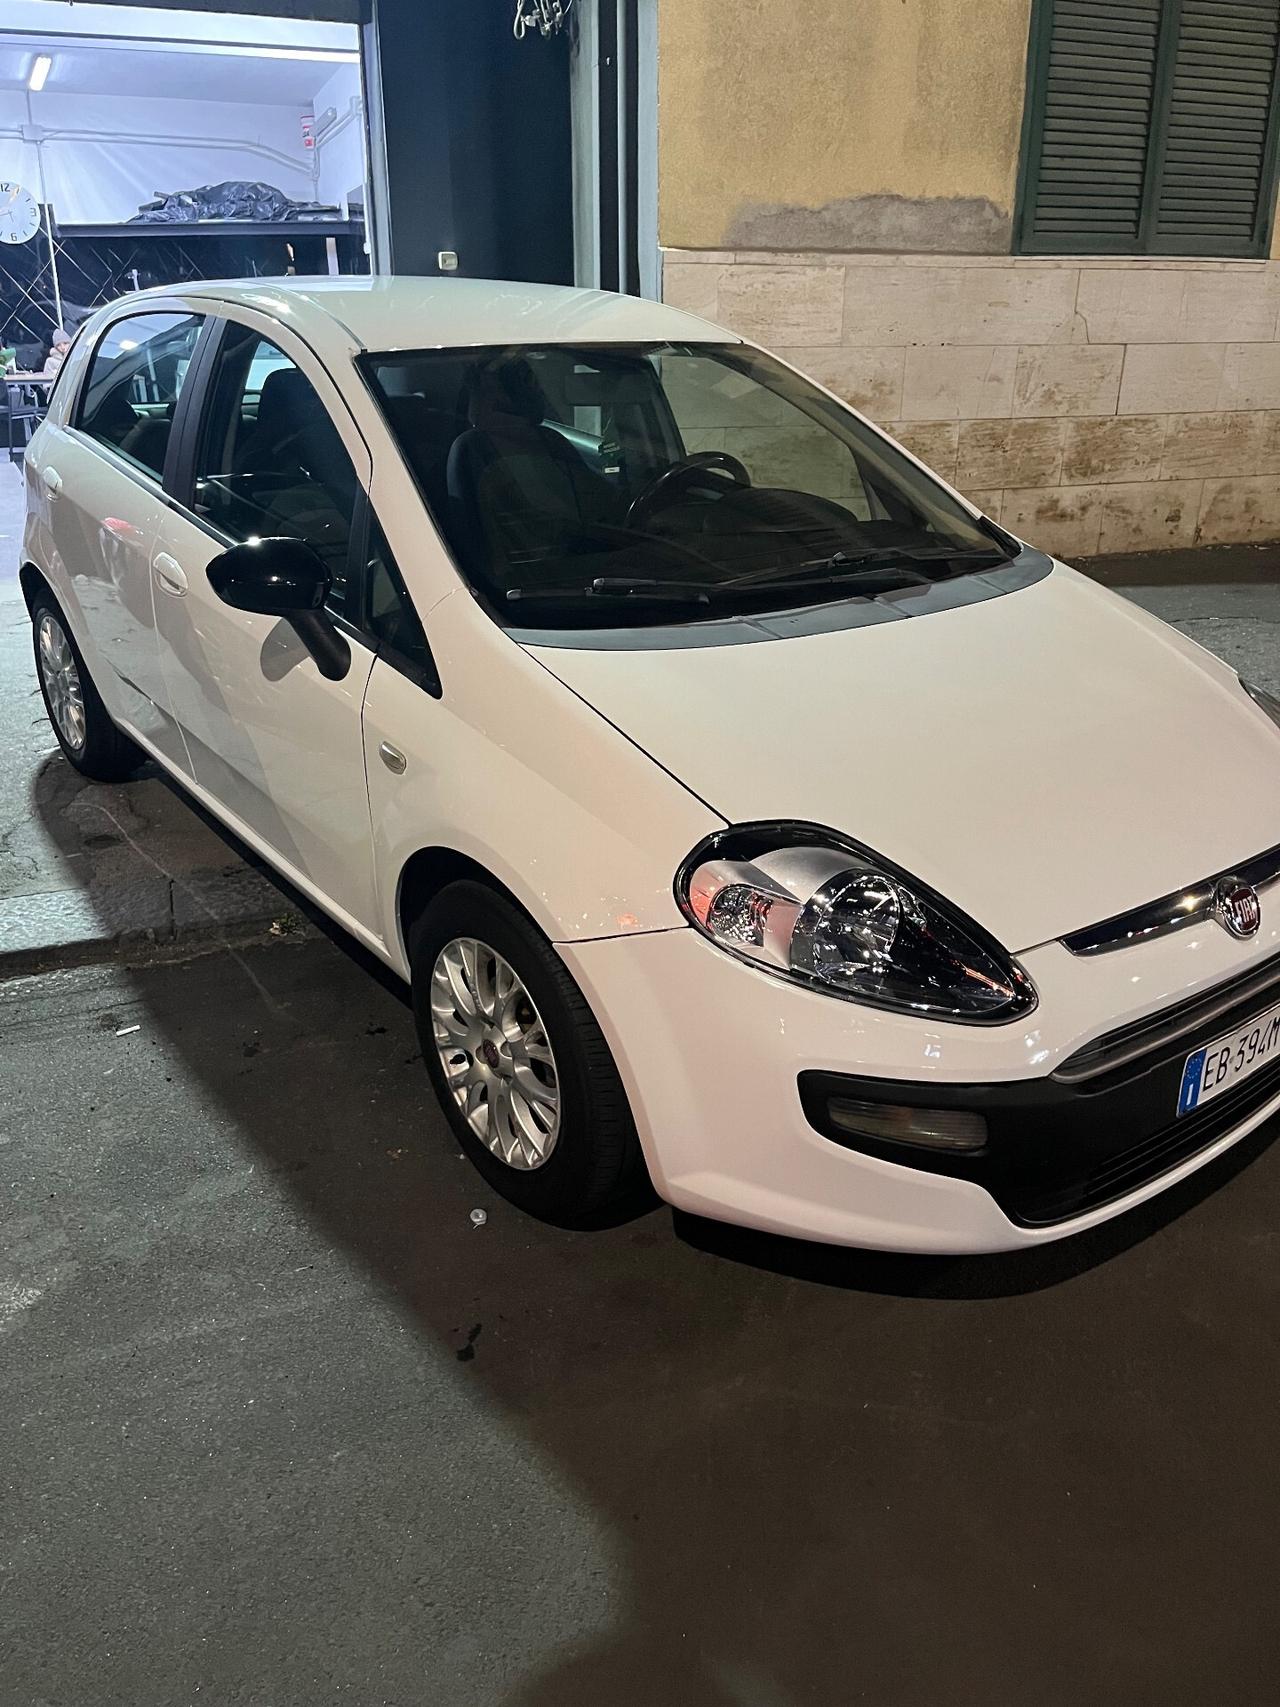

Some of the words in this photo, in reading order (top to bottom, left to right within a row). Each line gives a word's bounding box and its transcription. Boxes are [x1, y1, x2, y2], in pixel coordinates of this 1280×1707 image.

[0, 182, 11, 193] 12
[29, 207, 37, 217] 3
[10, 232, 18, 242] 6
[1234, 895, 1258, 923] FIAT
[1203, 1046, 1231, 1092] EB
